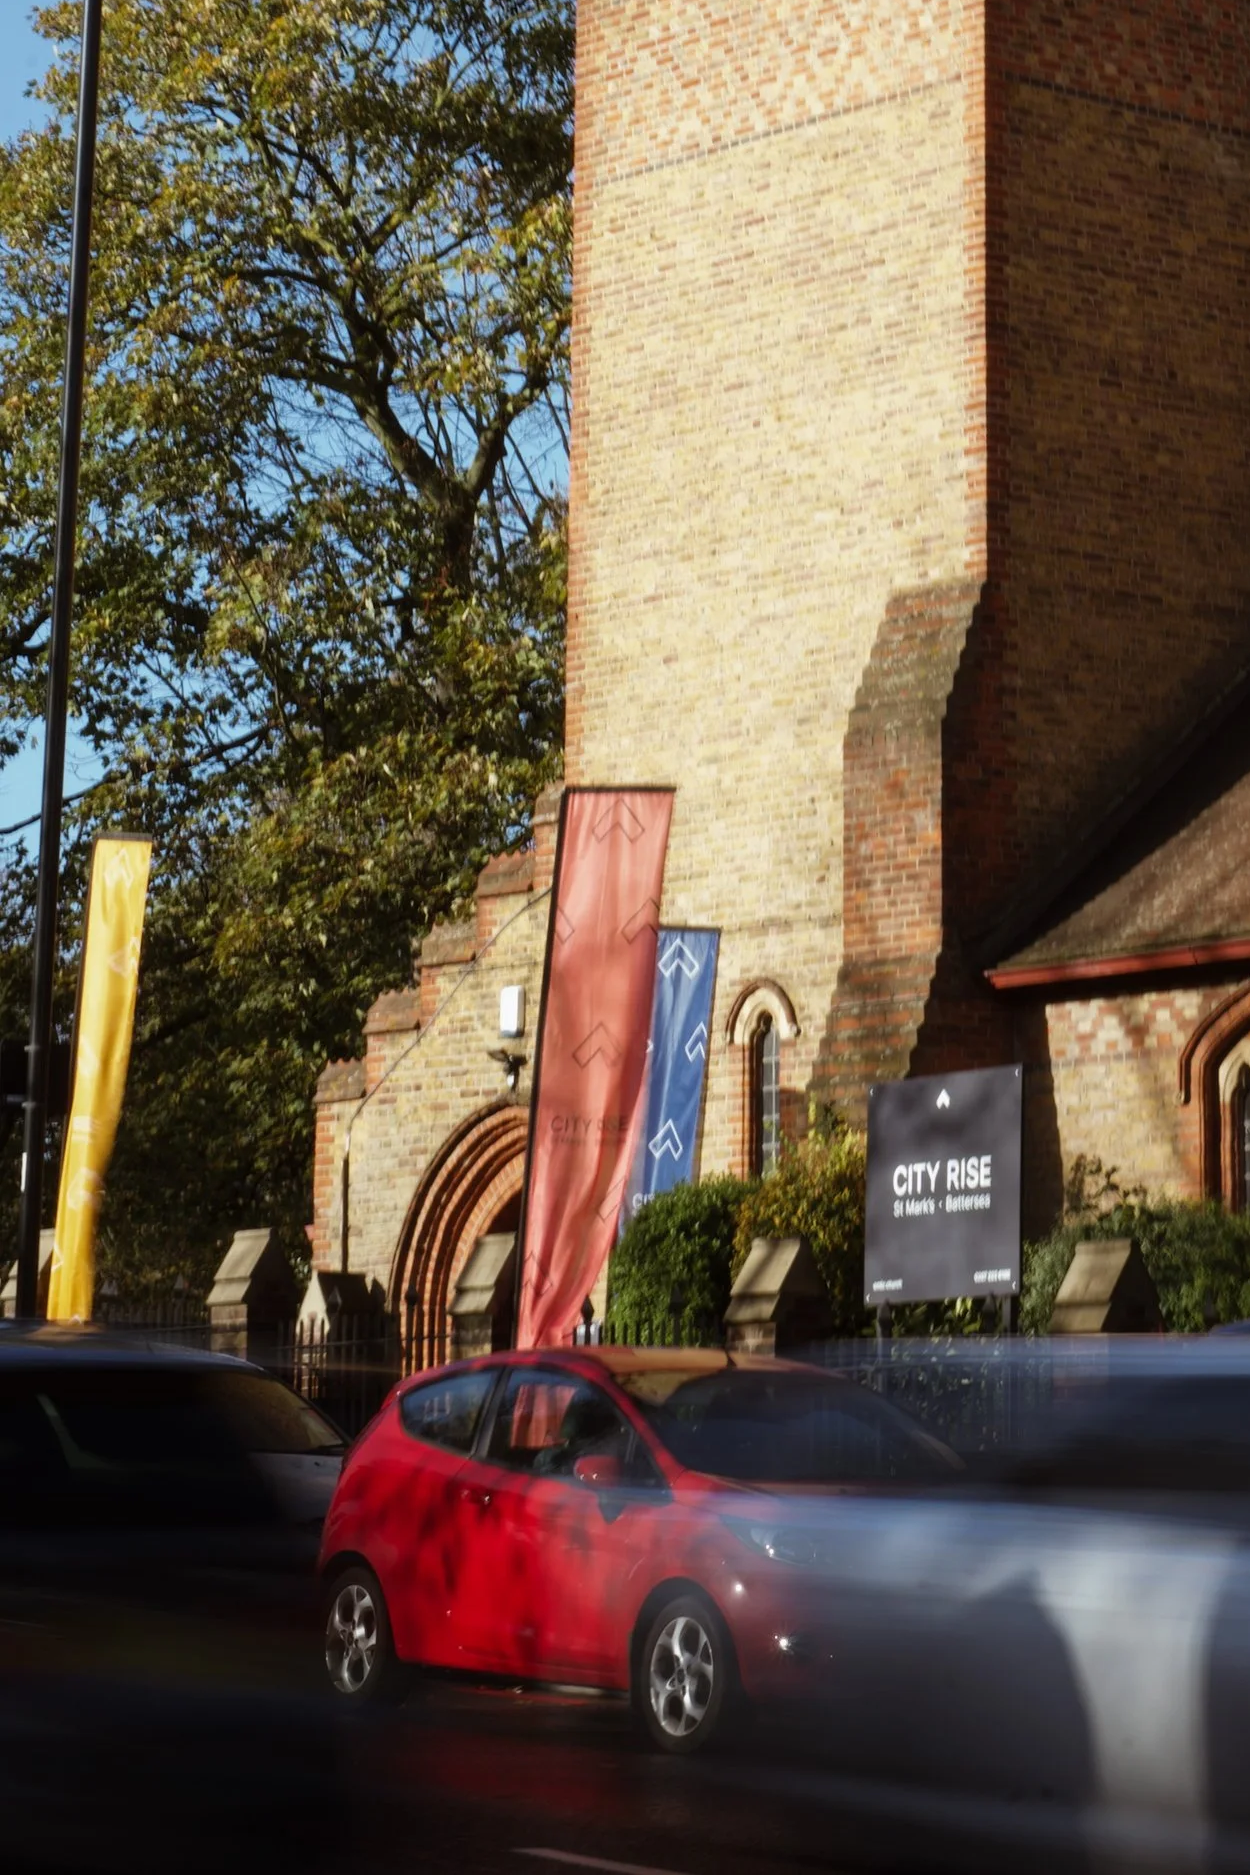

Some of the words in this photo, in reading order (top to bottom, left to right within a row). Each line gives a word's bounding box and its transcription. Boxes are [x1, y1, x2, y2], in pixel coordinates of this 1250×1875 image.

[550, 1115, 592, 1135] CITY
[893, 1160, 941, 1196] CITY
[946, 1154, 992, 1191] RISE
[893, 1199, 904, 1218] St
[905, 1197, 935, 1216] Mark's
[945, 1193, 991, 1213] Battersea
